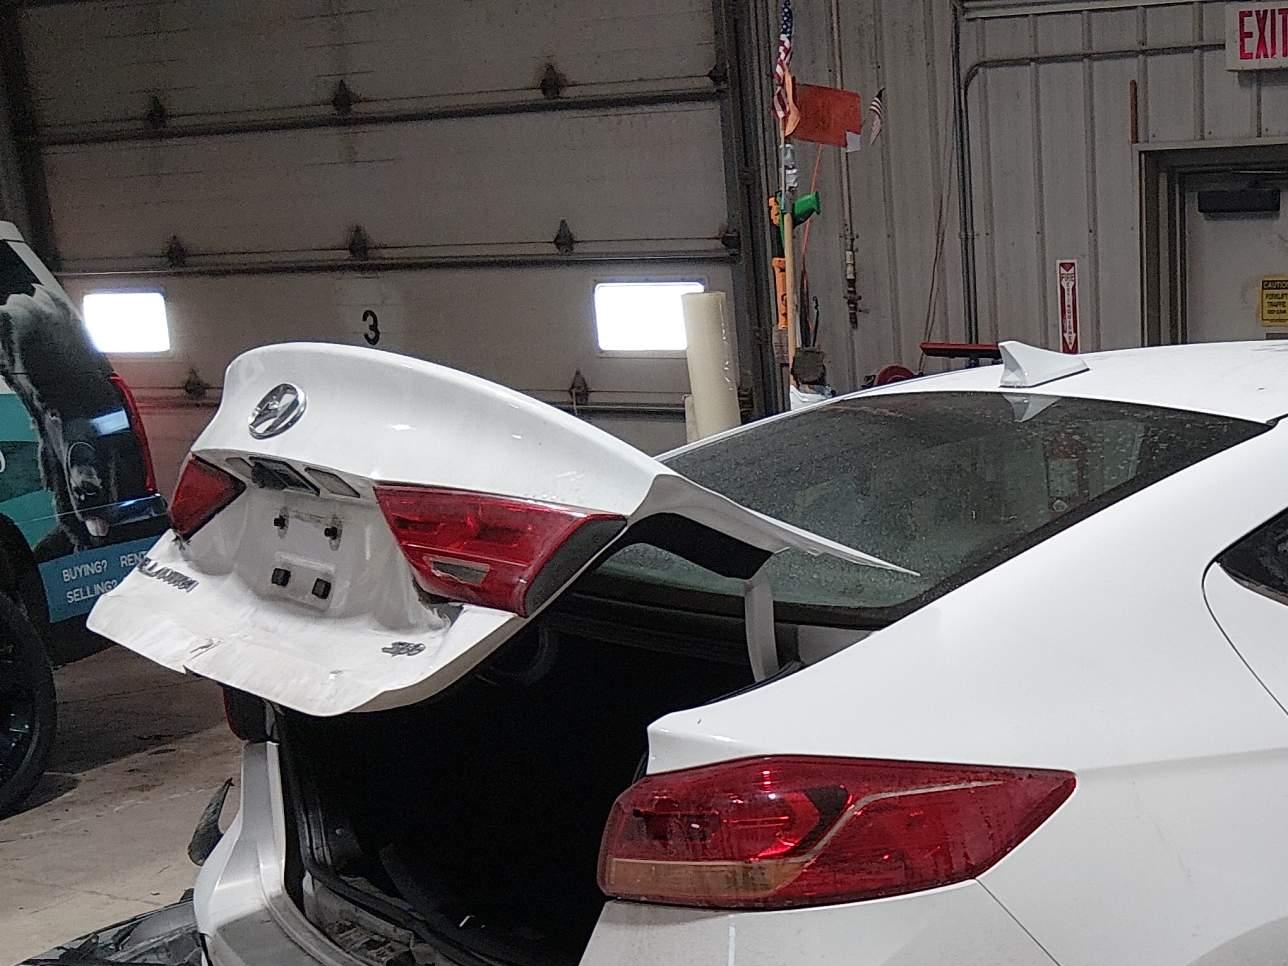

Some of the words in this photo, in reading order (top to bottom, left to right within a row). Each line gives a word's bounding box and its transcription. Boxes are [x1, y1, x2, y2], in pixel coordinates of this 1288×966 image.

[362, 310, 380, 346] 3
[62, 560, 108, 582] BUYING?
[66, 579, 118, 604] SELLING?
